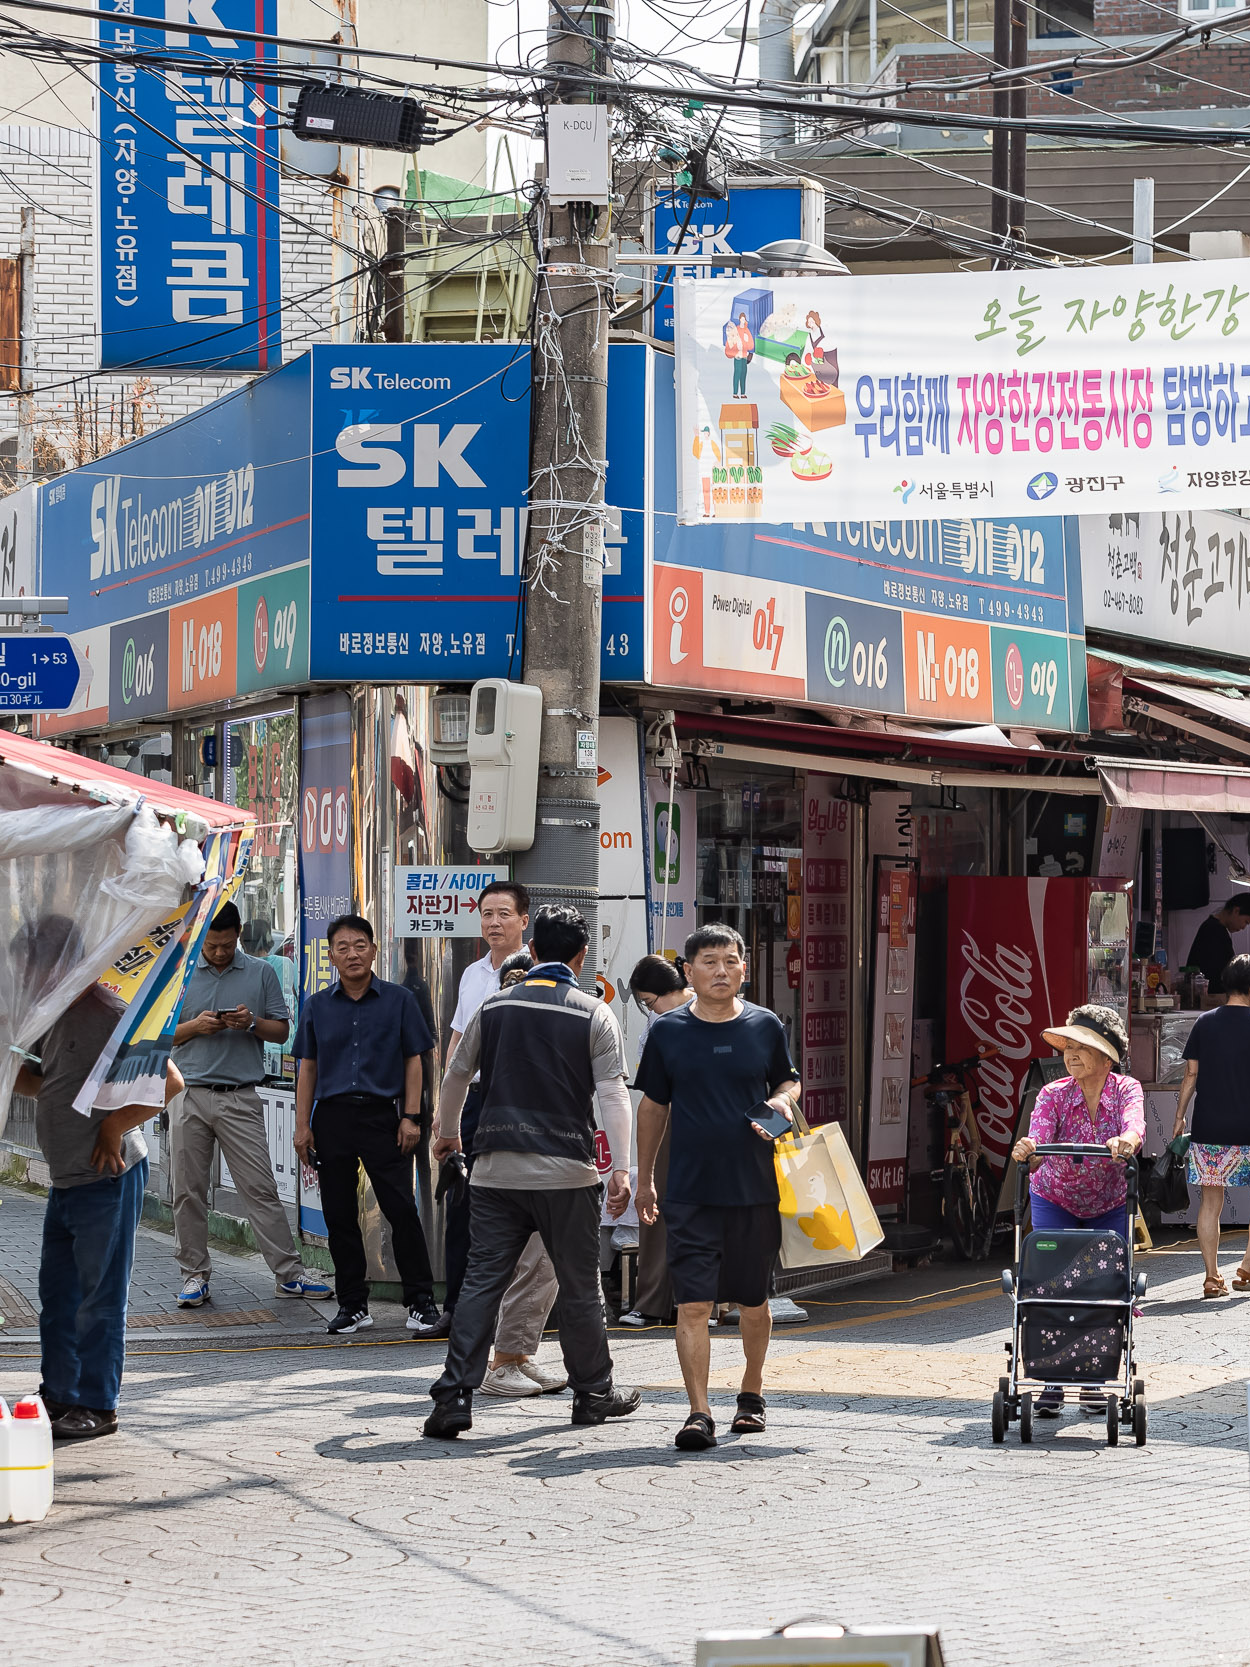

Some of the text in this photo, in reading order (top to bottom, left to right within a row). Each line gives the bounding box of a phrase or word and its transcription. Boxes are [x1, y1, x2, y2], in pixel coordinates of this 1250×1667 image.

[563, 120, 592, 131] K-DCU
[974, 285, 1046, 356] 오늘
[1063, 283, 1249, 342] 자양한강
[330, 367, 451, 390] SK Telecom
[854, 373, 951, 459] 우리함께
[956, 368, 1154, 455] 자양한강전통시장
[335, 424, 487, 488] SK
[919, 480, 994, 500] 서울특별시
[1064, 475, 1125, 493] 광진구
[90, 475, 121, 581] SK
[122, 492, 183, 570] Telecom
[712, 594, 731, 613] Power
[732, 598, 752, 618] Digital
[339, 632, 409, 656] 바로정보통신
[419, 632, 486, 656] 자양,노유점
[249, 743, 280, 799] BIG
[808, 799, 848, 846] 업무내용
[407, 895, 458, 915] 자판기
[410, 920, 455, 931] 카드가능
[870, 1166, 904, 1189] SK kt LG
